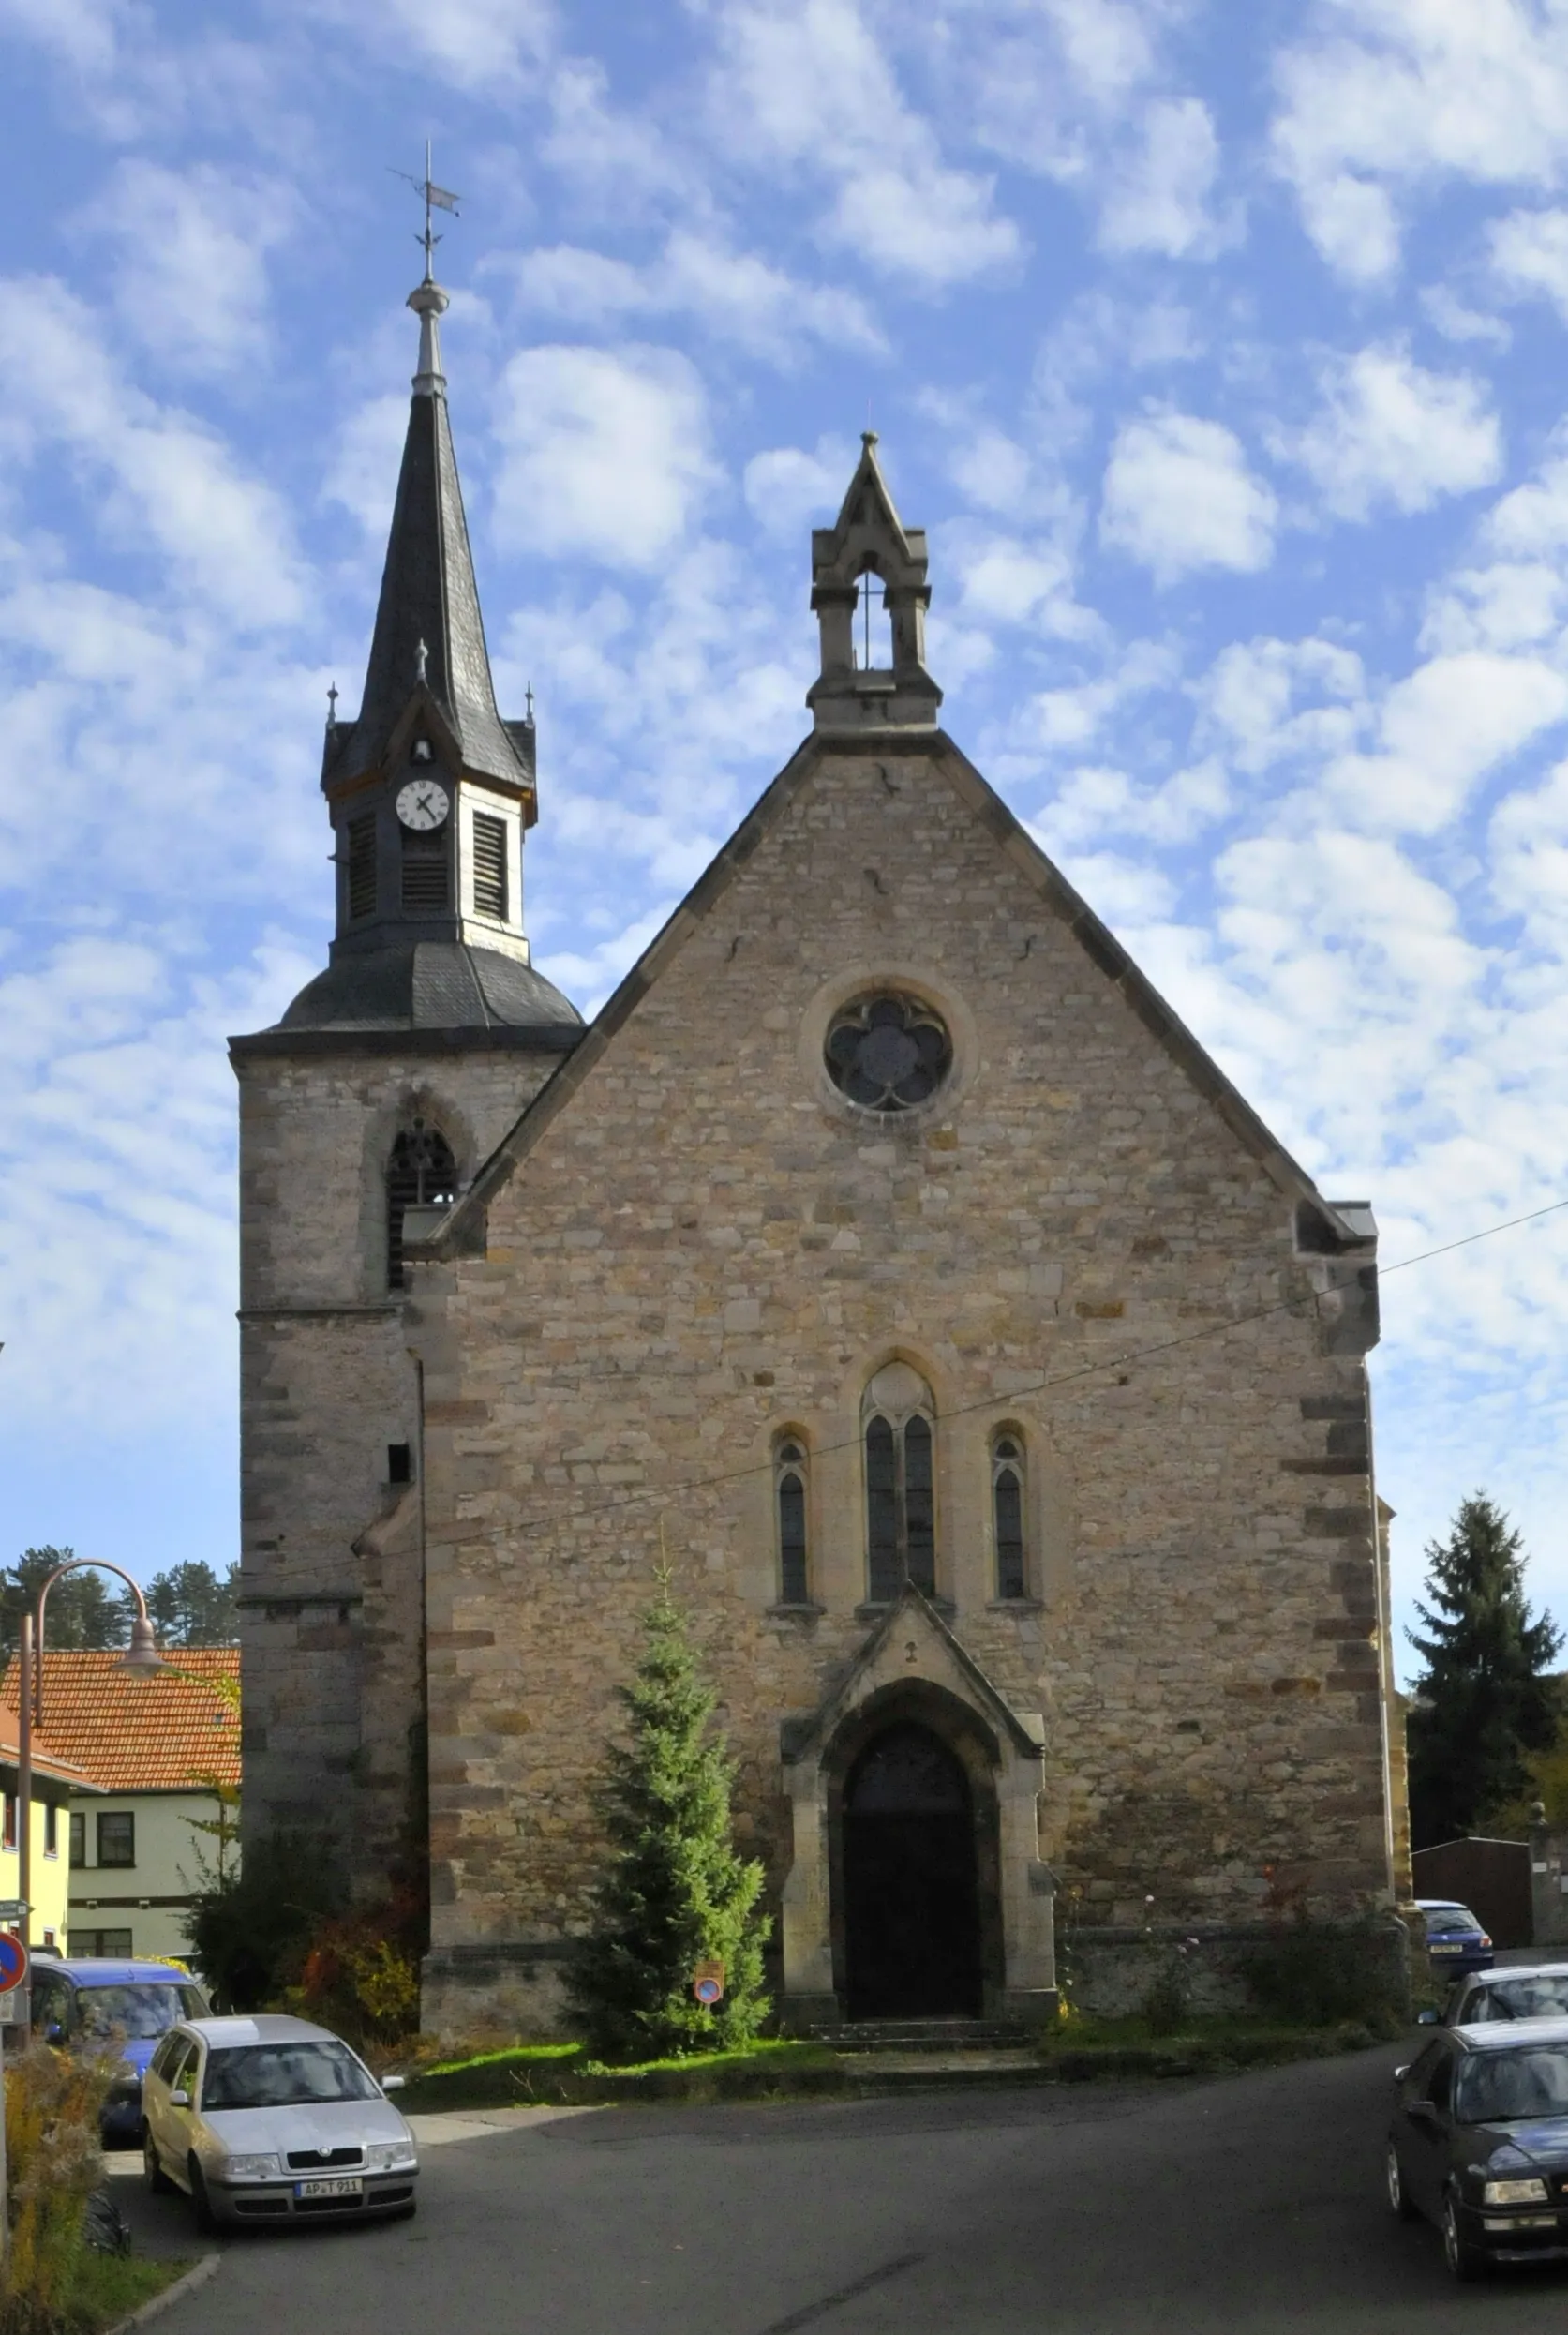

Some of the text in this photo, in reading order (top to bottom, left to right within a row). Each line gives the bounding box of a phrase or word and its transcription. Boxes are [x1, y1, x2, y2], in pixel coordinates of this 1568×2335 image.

[306, 2180, 357, 2194] AP T 911
